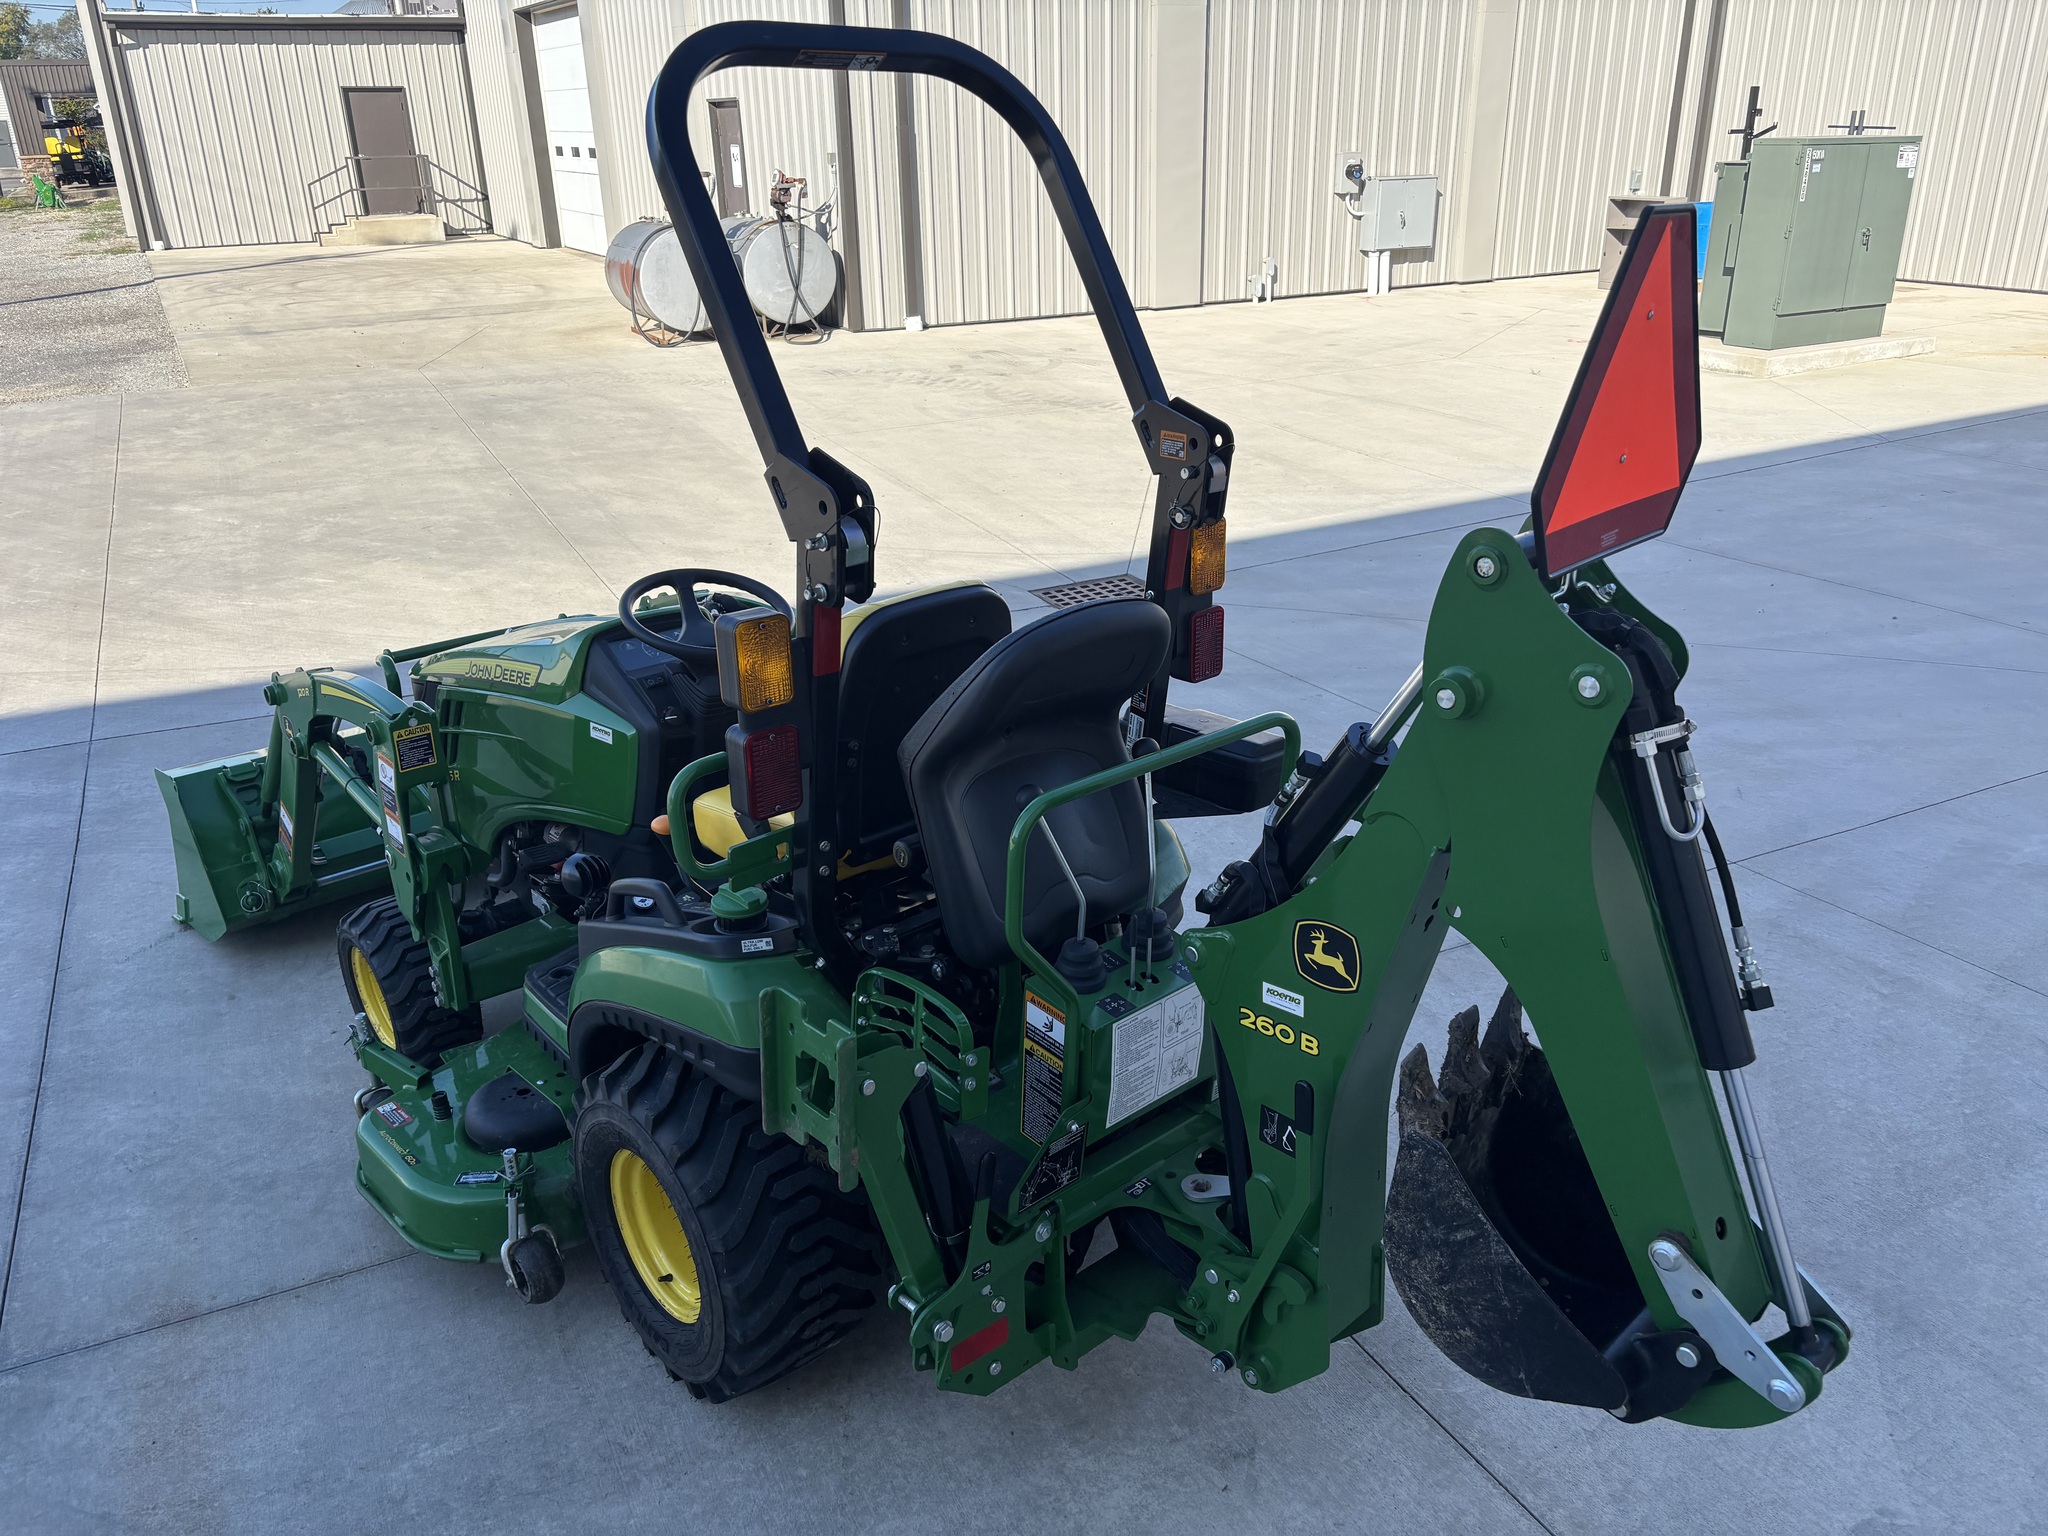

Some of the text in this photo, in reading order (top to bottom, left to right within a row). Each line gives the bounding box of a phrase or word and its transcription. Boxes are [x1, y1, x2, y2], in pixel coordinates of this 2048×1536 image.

[465, 661, 531, 685] JOHN DEERE
[404, 725, 430, 736] CAUTION
[1036, 1000, 1065, 1023] WARNING
[1240, 1006, 1319, 1055] 260 B
